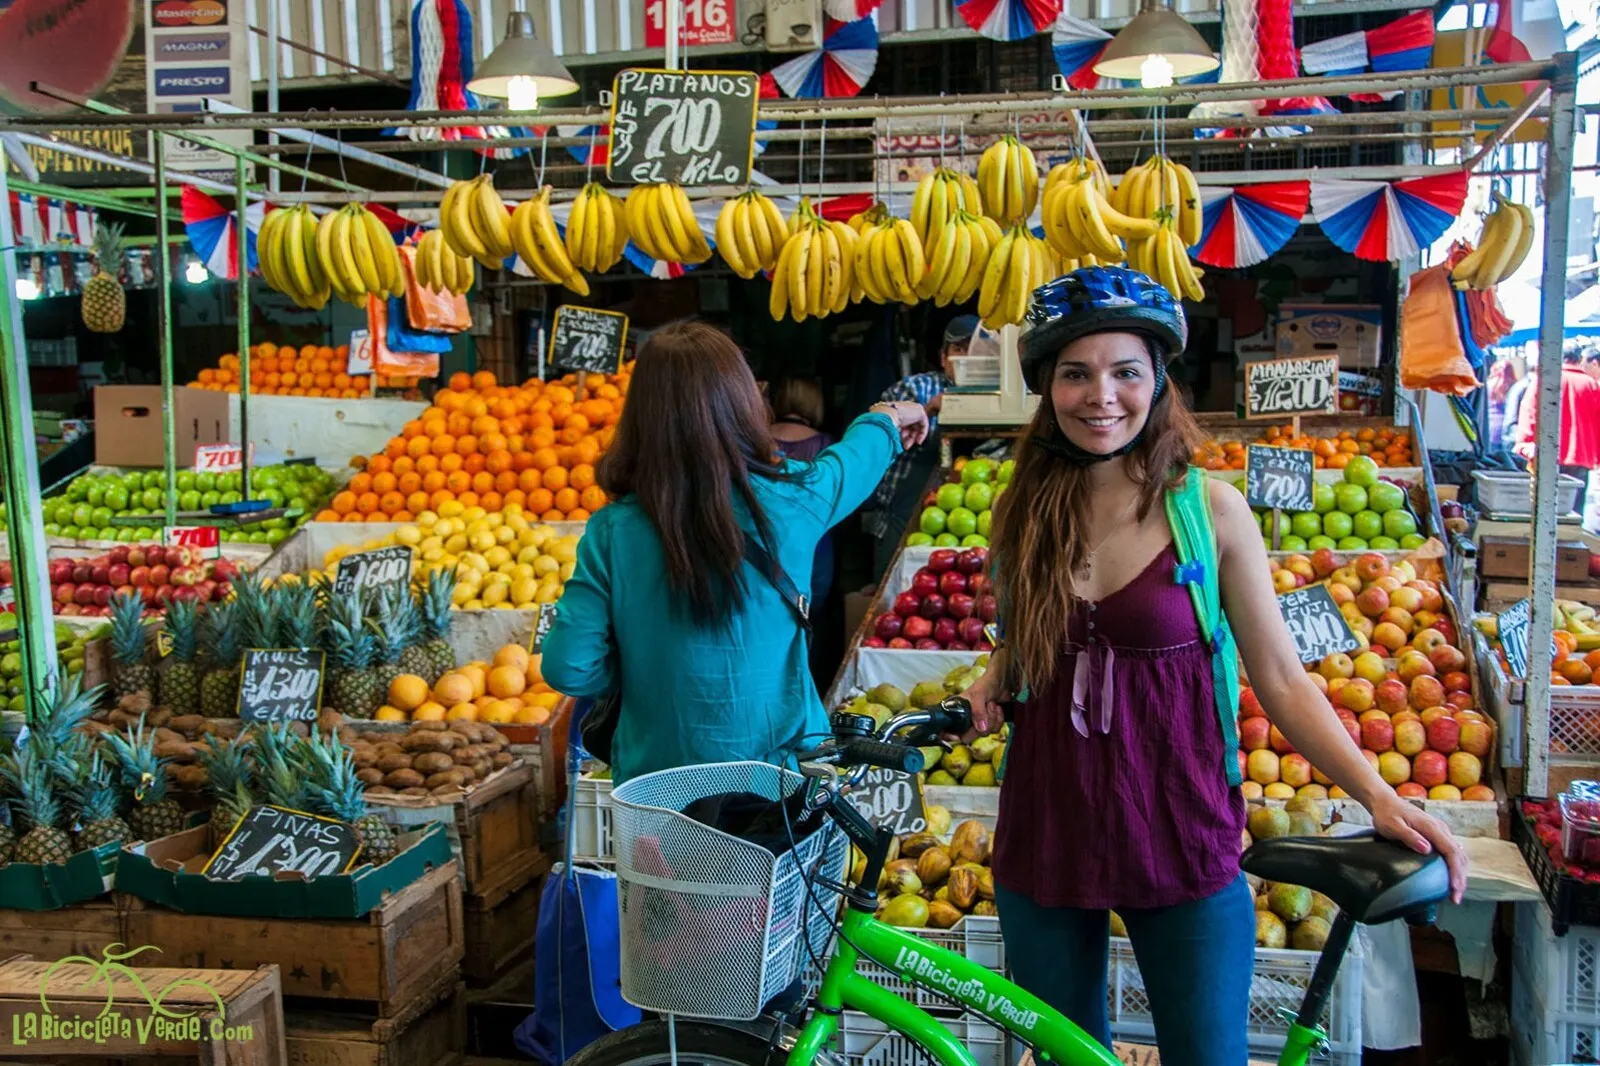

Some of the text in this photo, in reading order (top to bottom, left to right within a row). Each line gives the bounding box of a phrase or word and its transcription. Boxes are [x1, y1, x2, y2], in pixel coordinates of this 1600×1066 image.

[156, 7, 224, 18] MasterCard
[161, 41, 219, 52] MAGNA
[160, 76, 225, 87] PRESTO
[620, 71, 752, 97] PLATANOS
[631, 160, 667, 183] EL
[1288, 600, 1330, 620] FUJI
[254, 704, 281, 720] EL
[253, 806, 345, 845] PIÑAS
